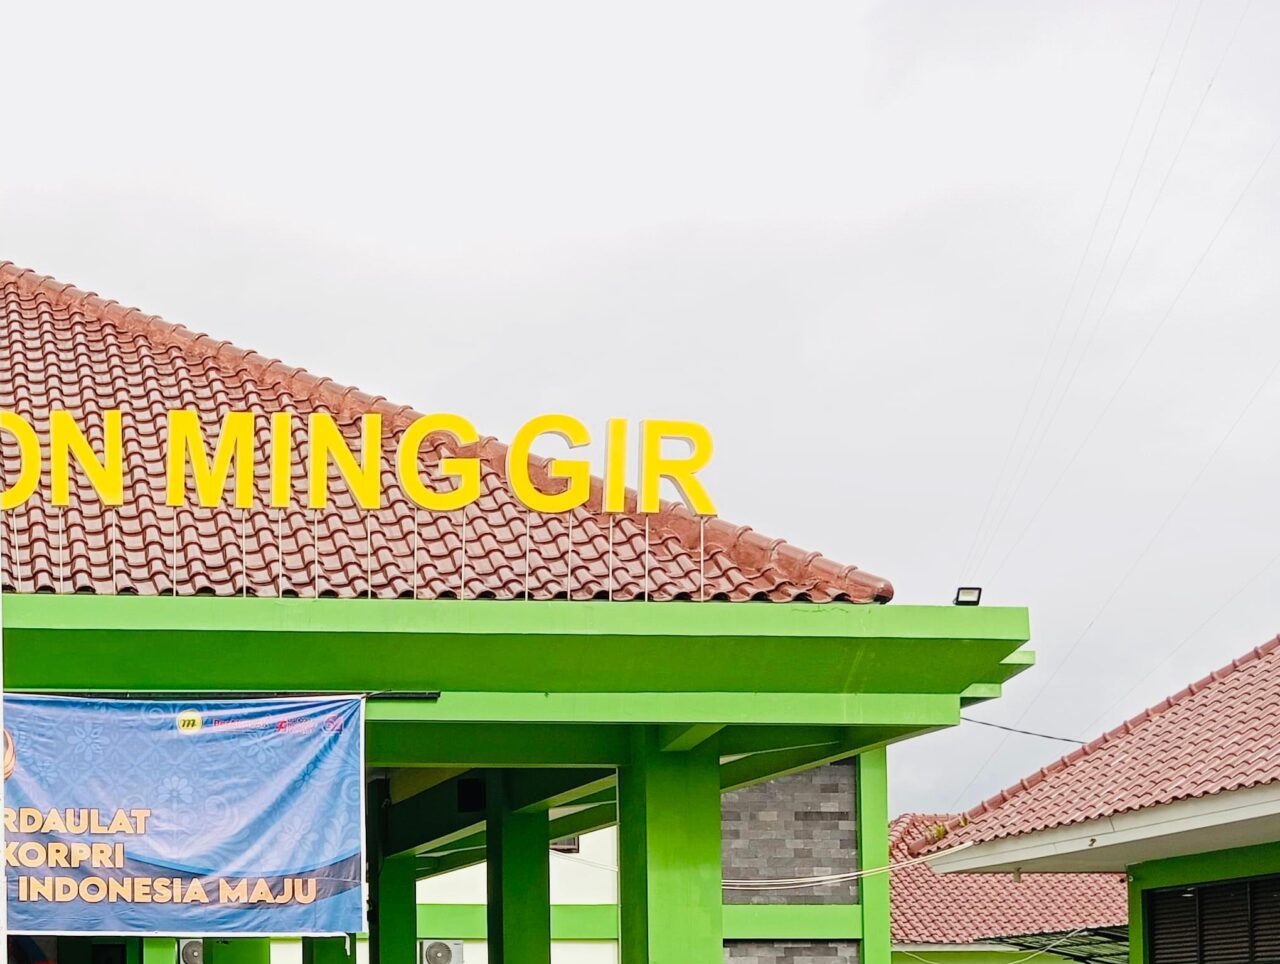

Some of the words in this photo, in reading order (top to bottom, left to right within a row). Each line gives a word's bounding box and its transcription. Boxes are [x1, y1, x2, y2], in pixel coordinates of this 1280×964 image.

[166, 408, 718, 517] MINGGIR
[18, 875, 210, 904] INDONESIA
[219, 877, 318, 905] MAJU
